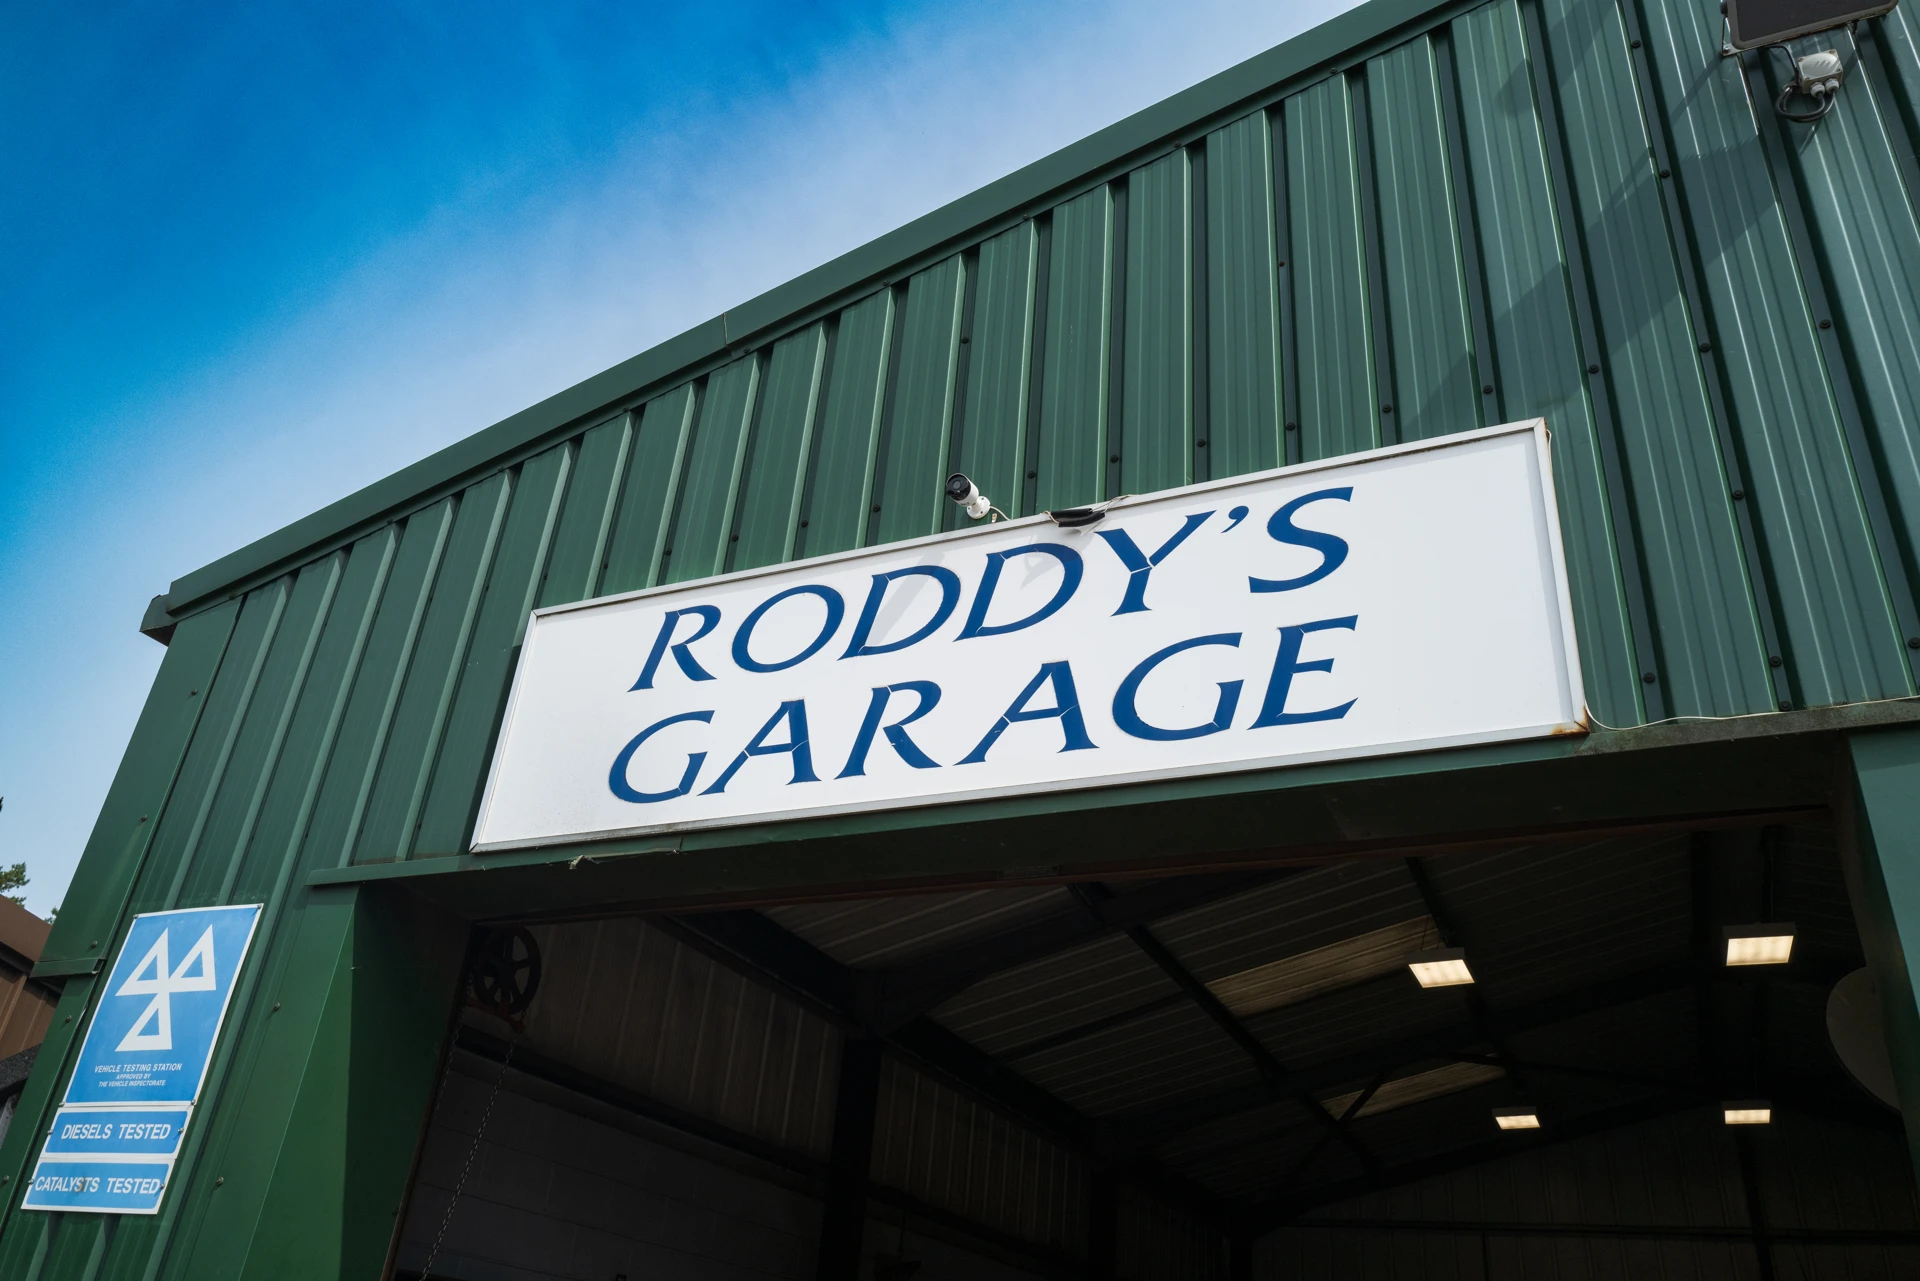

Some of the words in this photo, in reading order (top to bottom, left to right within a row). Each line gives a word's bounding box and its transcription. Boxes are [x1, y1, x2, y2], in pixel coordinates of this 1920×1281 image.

[628, 488, 1353, 691] RODDY'S
[609, 616, 1357, 803] GARAGE
[94, 1065, 121, 1073] VEHICLE
[122, 1064, 151, 1072] TESTING
[152, 1063, 182, 1071] STATION
[61, 1124, 113, 1139] DIESELS
[118, 1124, 171, 1139] TESTED
[35, 1176, 100, 1192] CATALYSTS
[106, 1178, 161, 1193] TESTED
